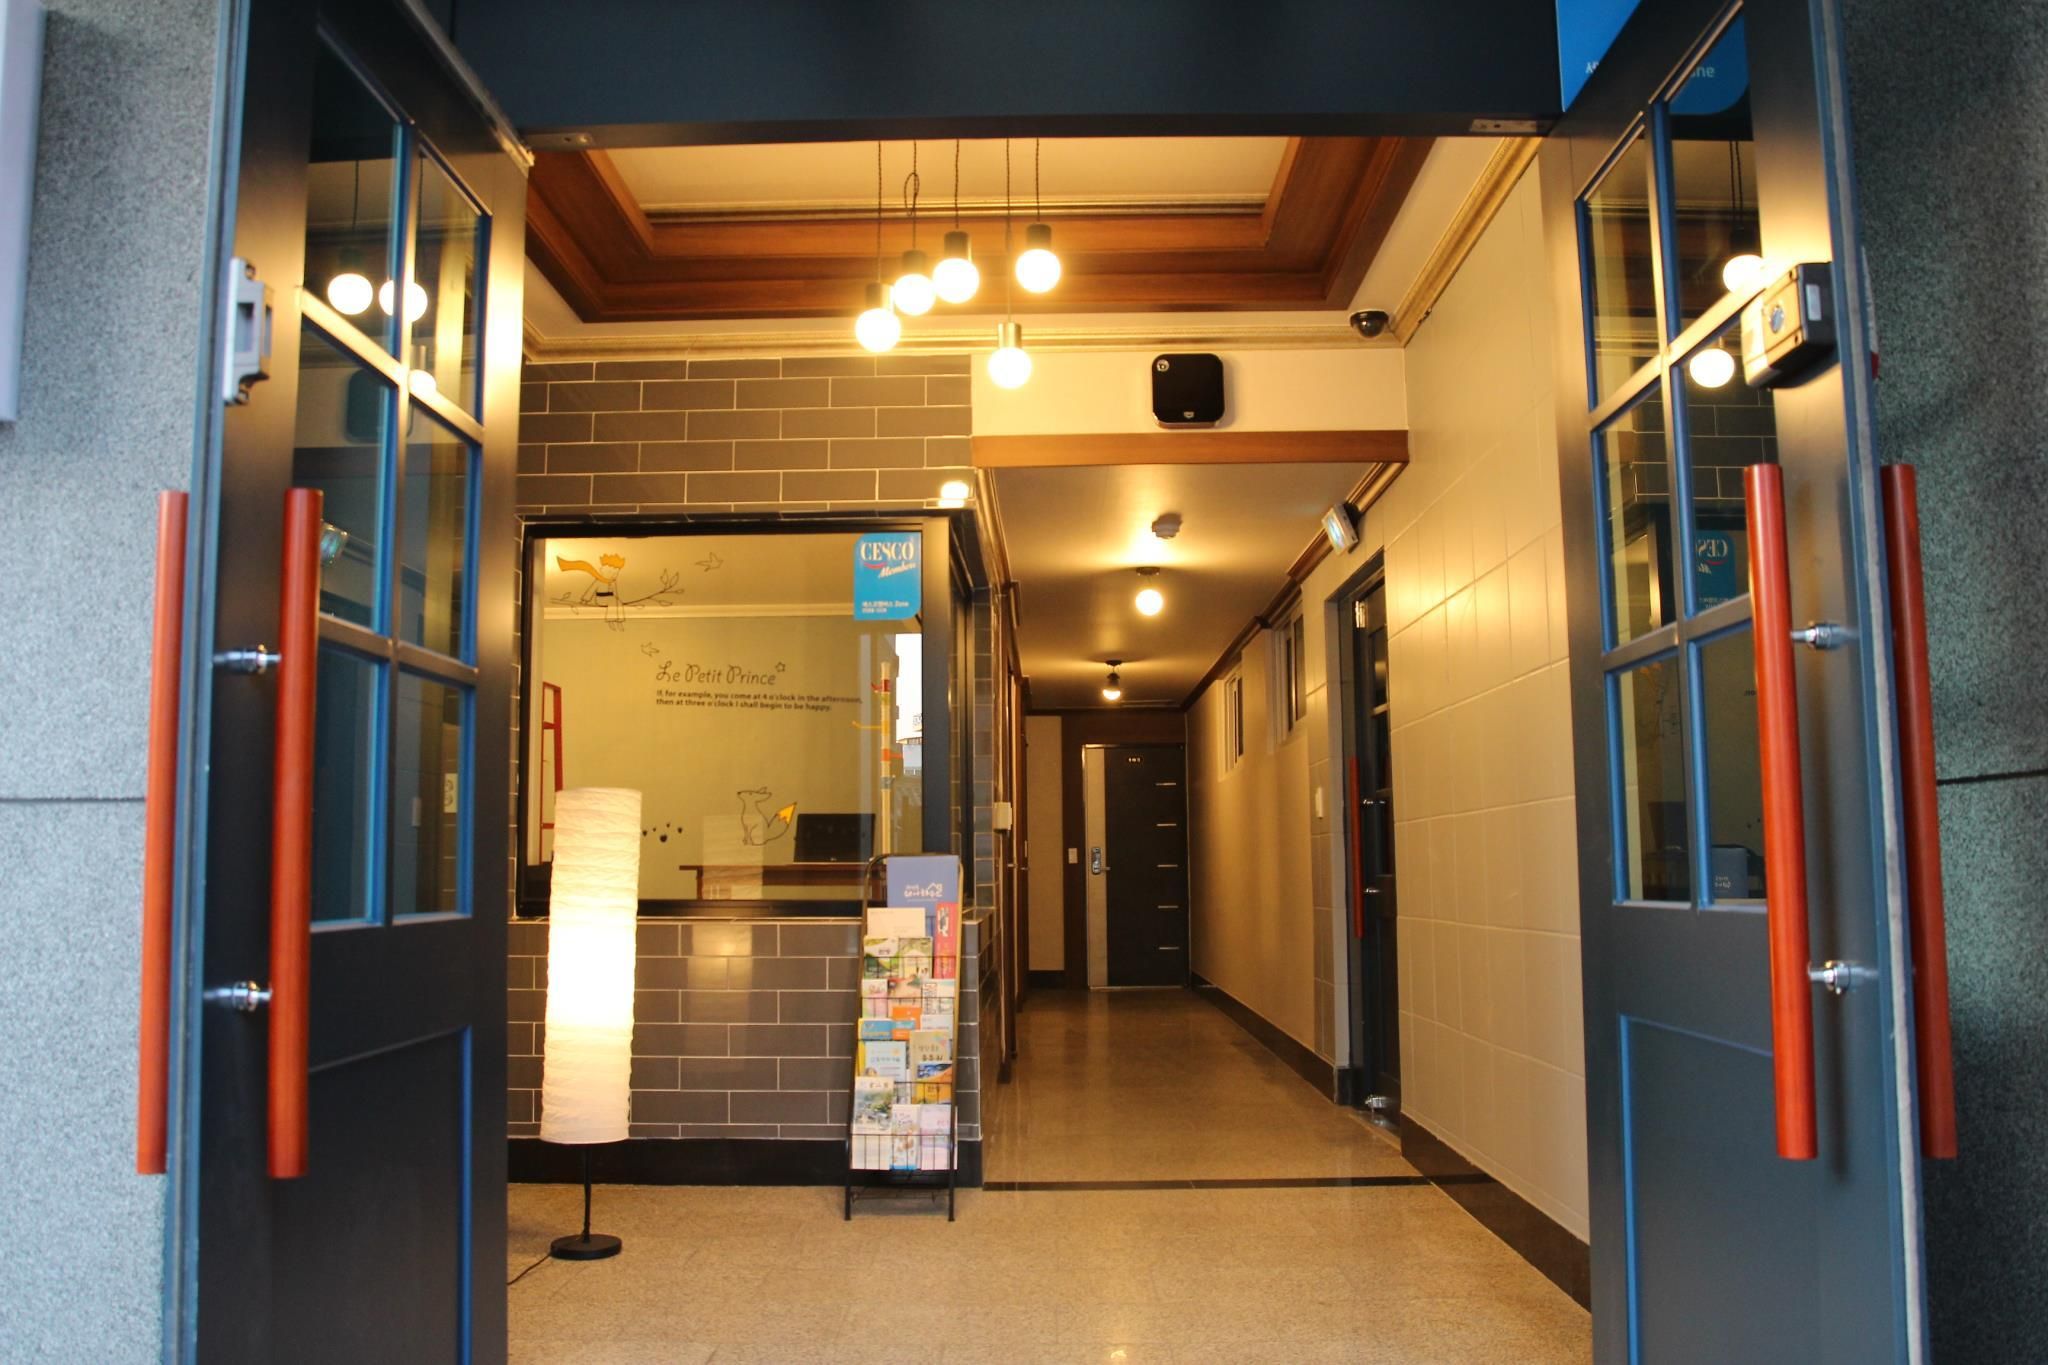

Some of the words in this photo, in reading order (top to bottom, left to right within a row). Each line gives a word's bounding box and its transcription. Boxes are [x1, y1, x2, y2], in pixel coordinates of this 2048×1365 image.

[861, 542, 914, 561] CESCO
[656, 660, 681, 682] Le
[685, 663, 721, 683] Petit
[727, 664, 776, 686] Prince
[760, 702, 782, 711] begin
